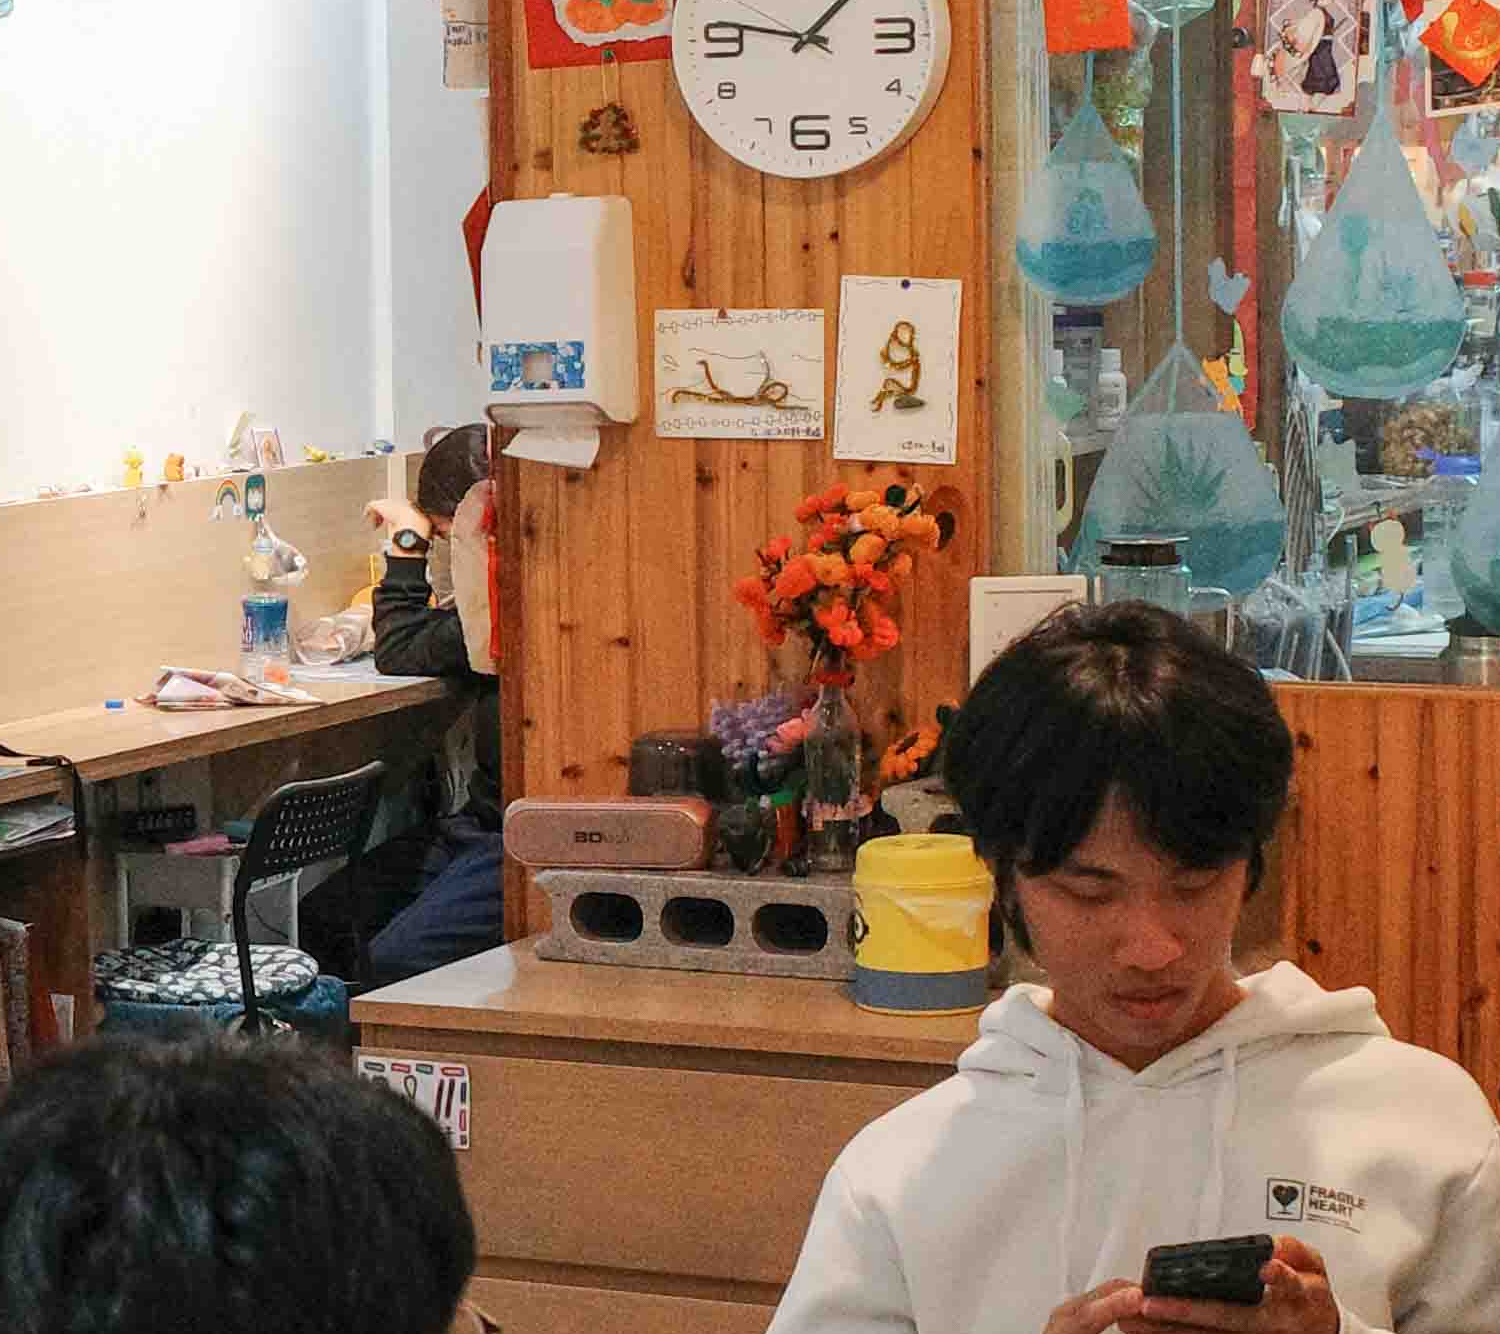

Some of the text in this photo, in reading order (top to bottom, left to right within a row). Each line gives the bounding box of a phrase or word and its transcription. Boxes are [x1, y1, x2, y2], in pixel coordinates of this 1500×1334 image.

[703, 21, 745, 59] 9
[874, 17, 916, 54] 3
[718, 81, 736, 100] 8
[885, 78, 902, 97] 4
[753, 117, 773, 135] 7
[790, 114, 831, 151] 6
[848, 116, 868, 135] 5
[1309, 1184, 1366, 1209] FRAGILE
[1308, 1197, 1353, 1216] HEART
